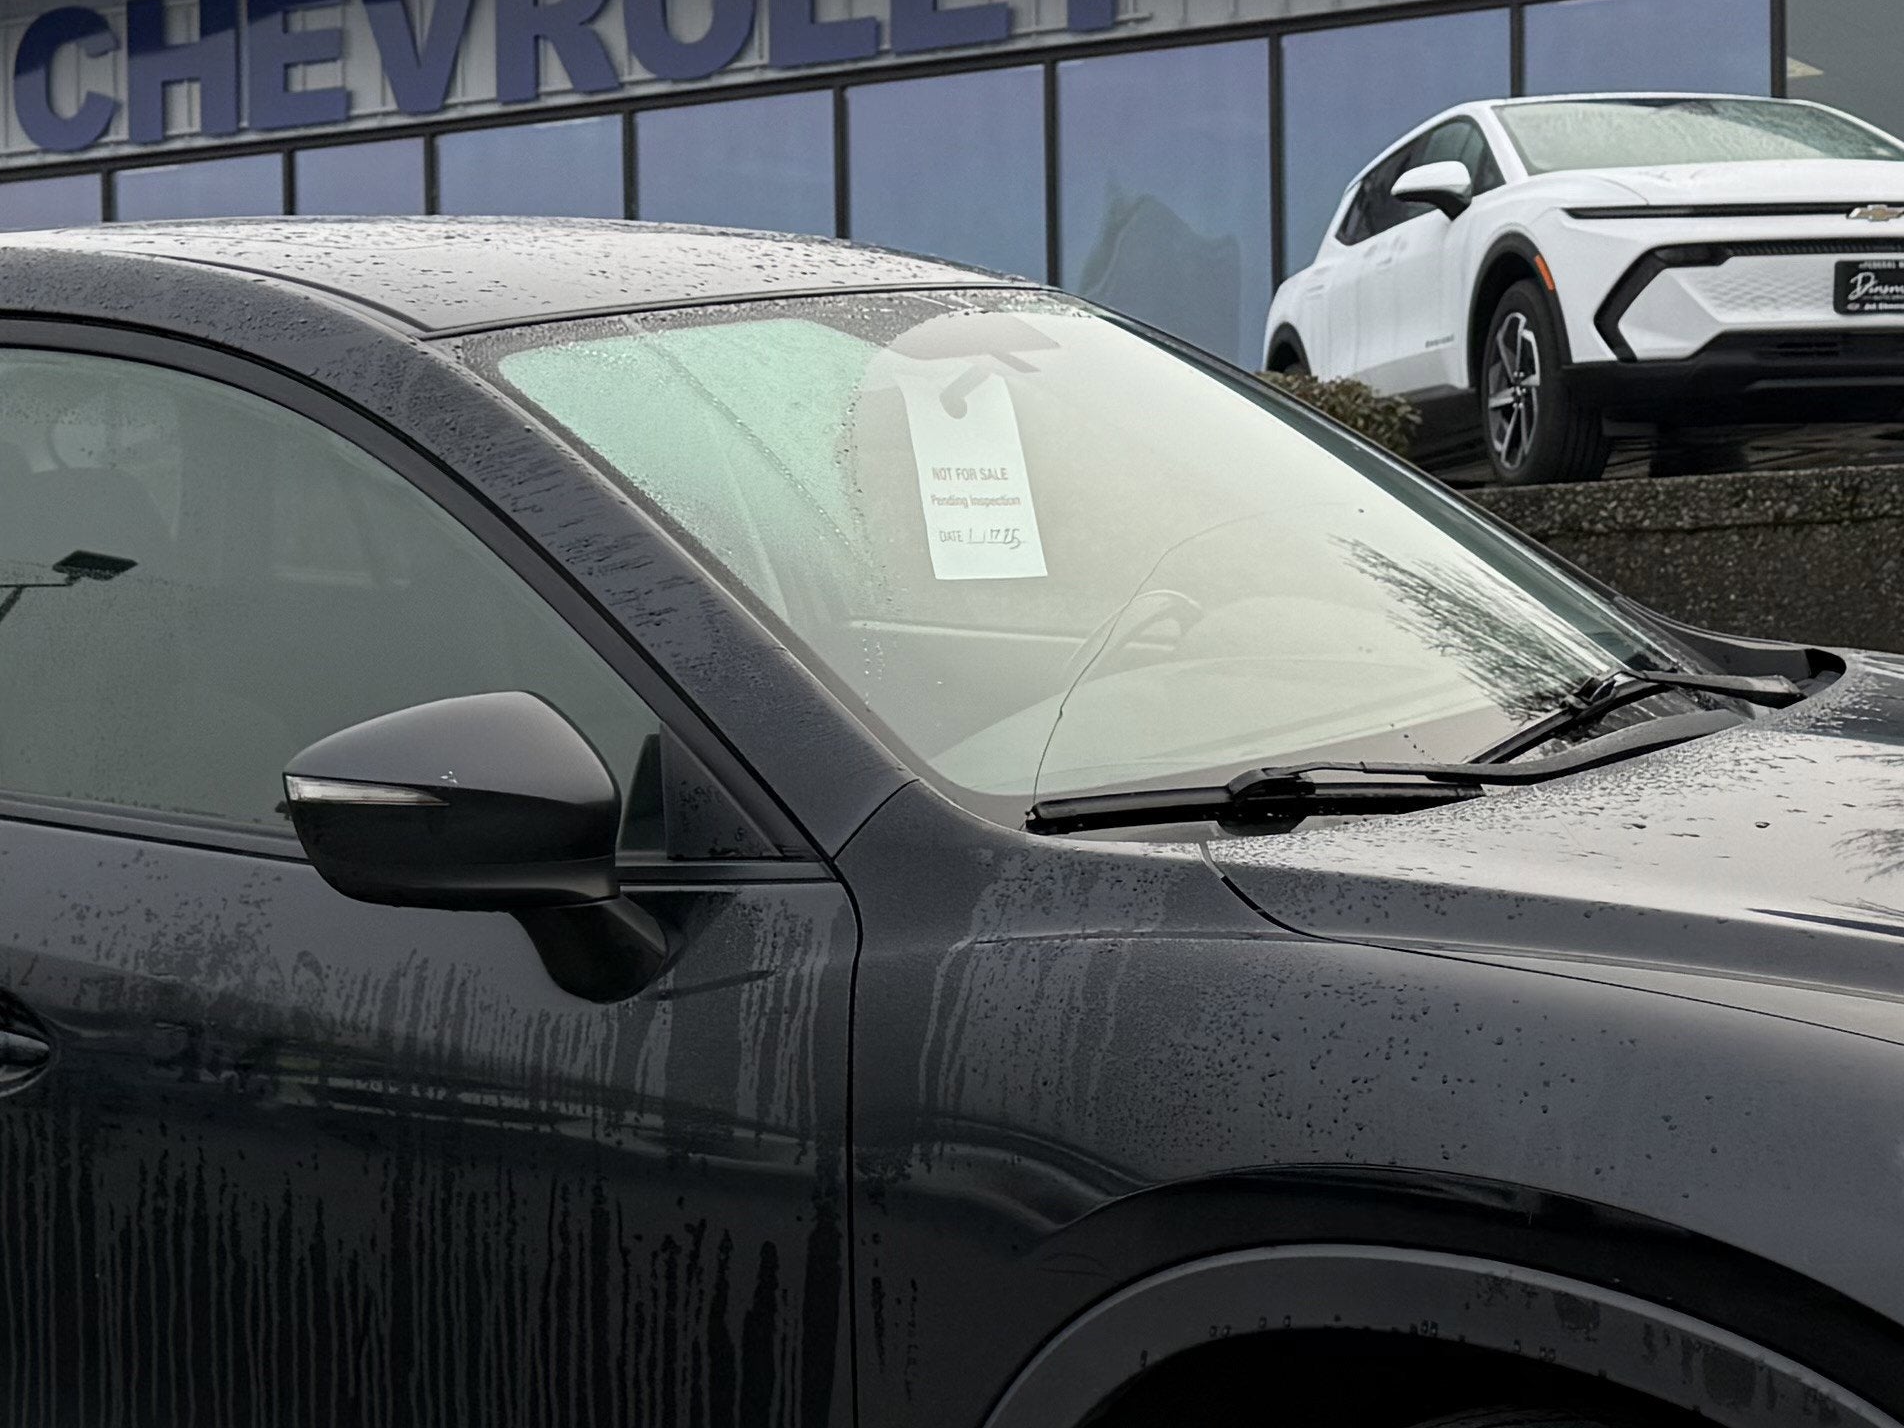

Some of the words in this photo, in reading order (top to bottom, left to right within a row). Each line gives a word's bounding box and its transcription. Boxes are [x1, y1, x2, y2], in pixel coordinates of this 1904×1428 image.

[932, 467, 953, 481] NOT
[956, 467, 978, 481] FOR
[979, 467, 1009, 481] SALE
[939, 529, 963, 542] DATE
